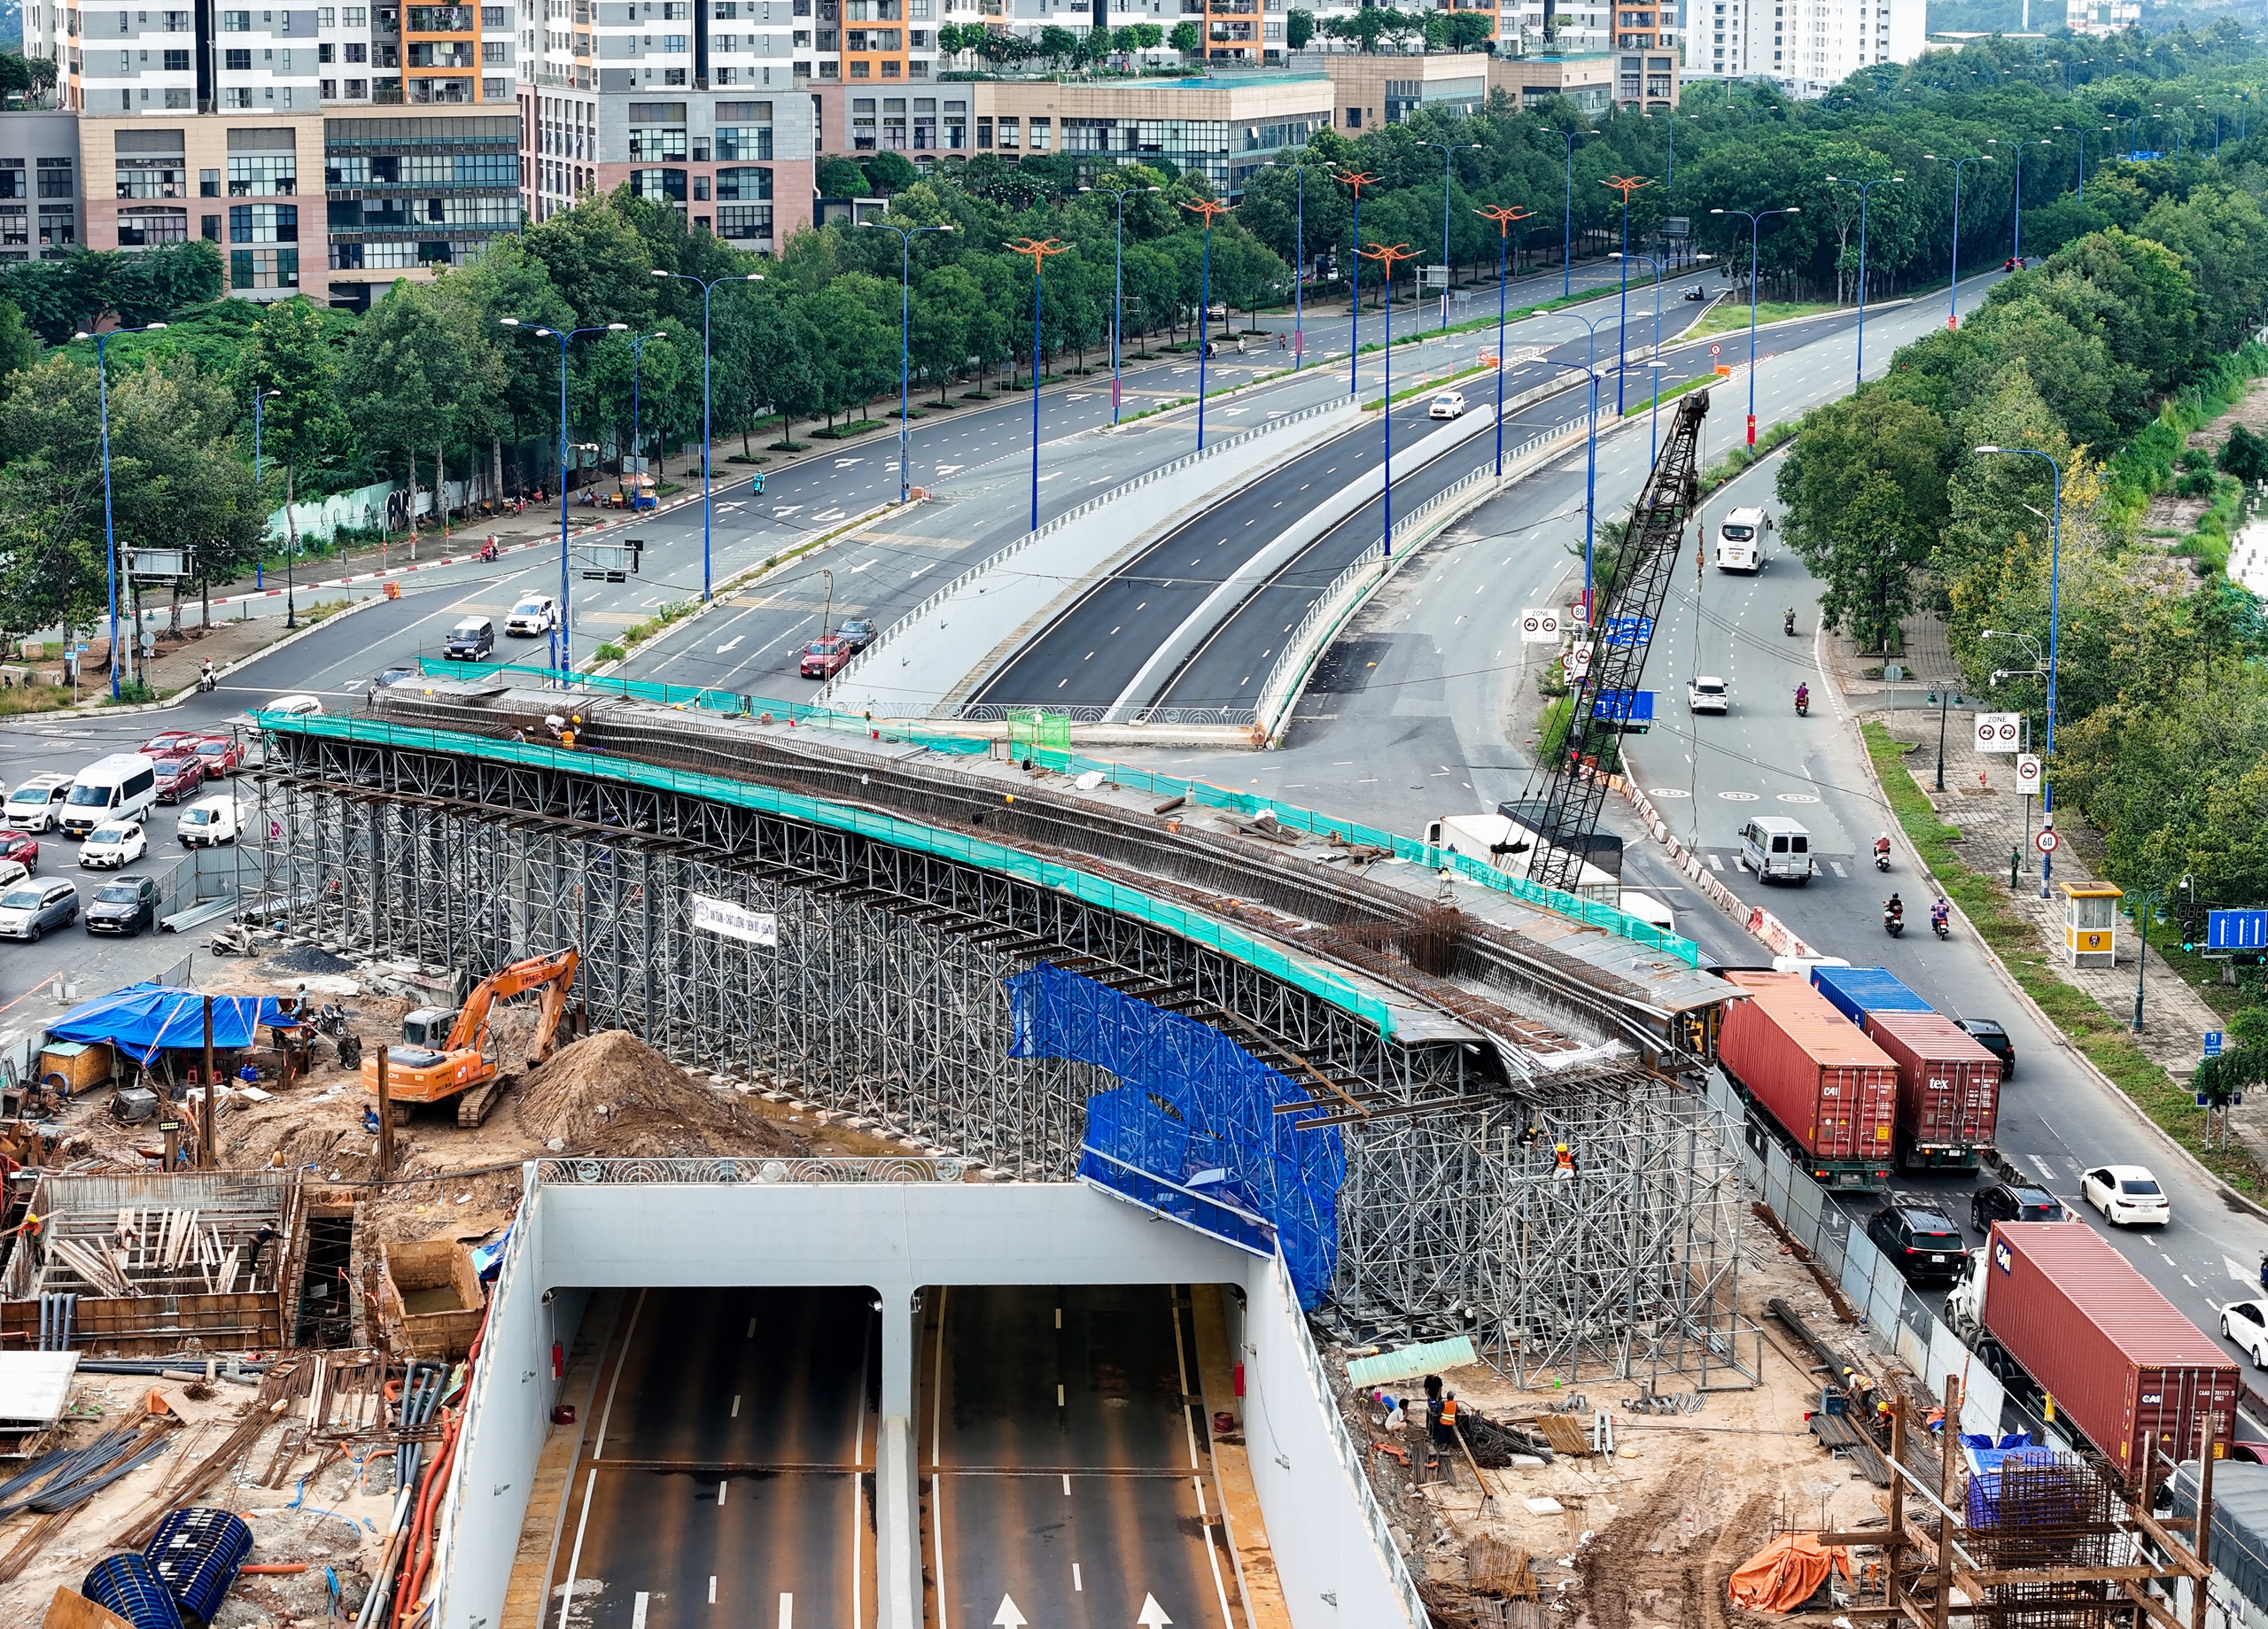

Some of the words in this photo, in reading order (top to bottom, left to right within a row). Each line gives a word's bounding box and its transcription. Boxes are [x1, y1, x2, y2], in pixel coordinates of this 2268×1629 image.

[2042, 837, 2053, 846] 60
[1930, 1077, 1949, 1089] tex
[1824, 1087, 1838, 1096] CAI
[2142, 1394, 2161, 1403] CAI
